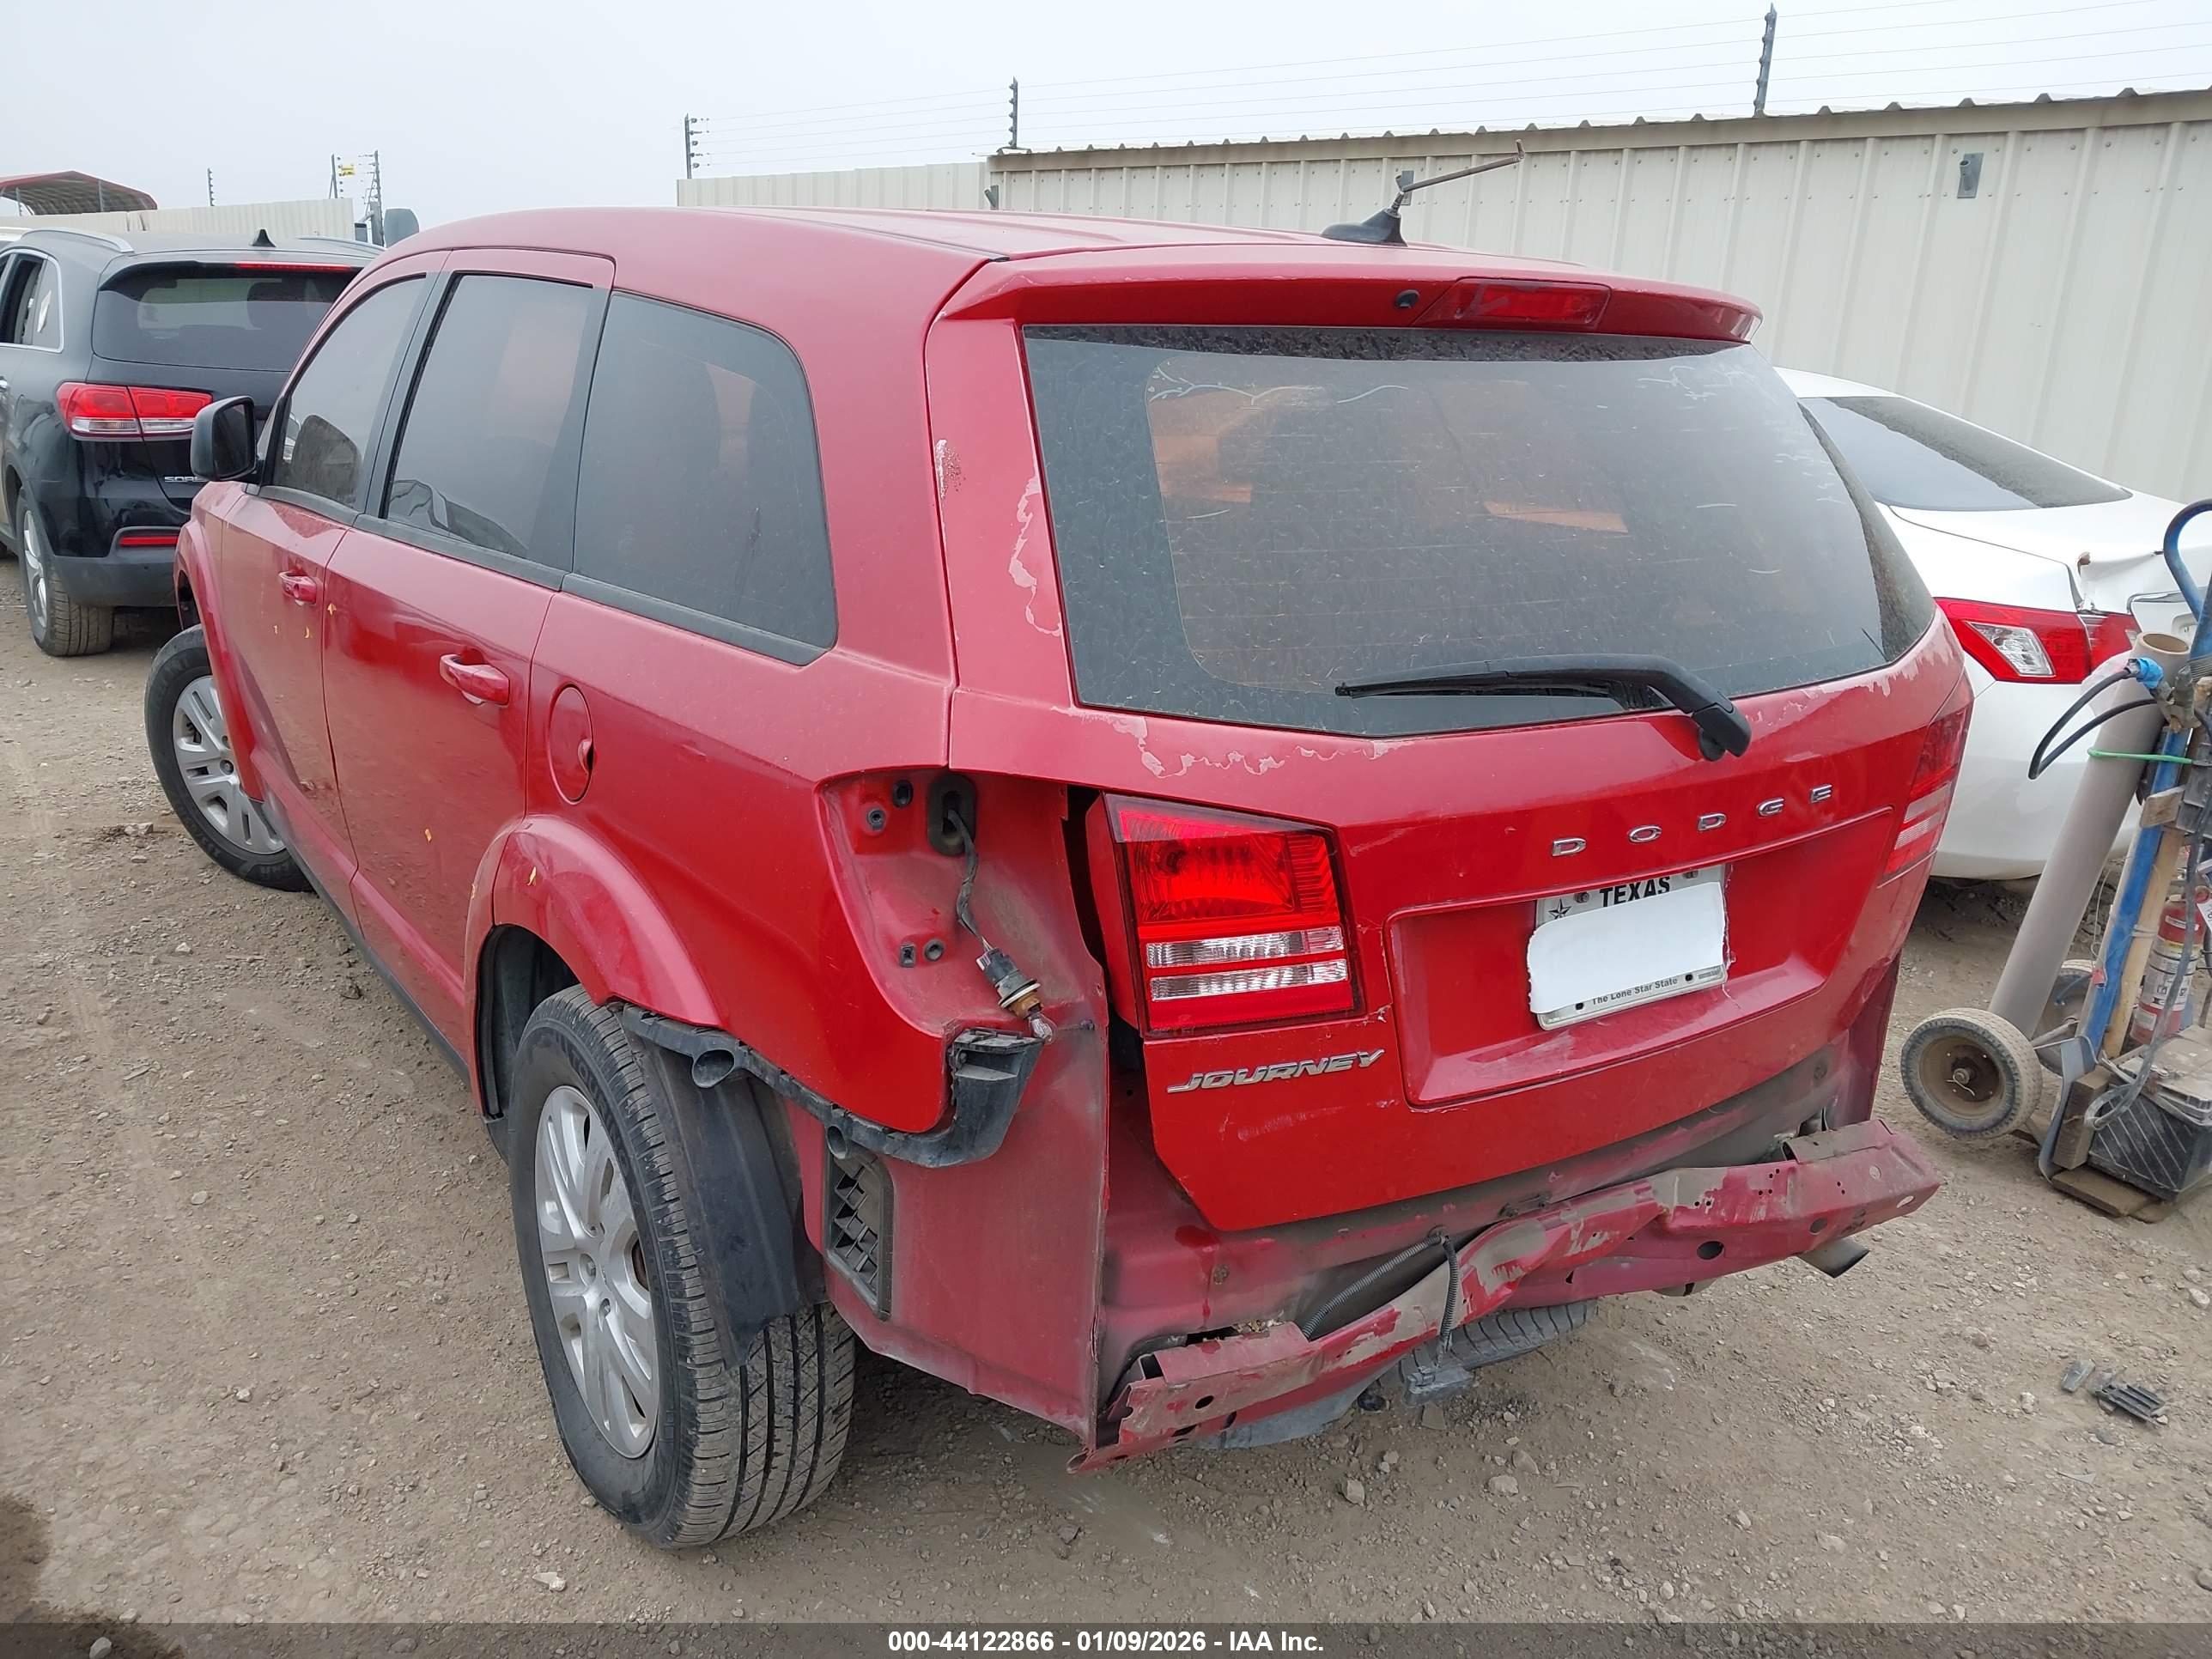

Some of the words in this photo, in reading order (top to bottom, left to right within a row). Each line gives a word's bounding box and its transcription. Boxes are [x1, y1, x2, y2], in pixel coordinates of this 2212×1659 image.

[1552, 783, 1832, 857] DODGE
[1599, 876, 1670, 908] TEXAS
[1592, 996, 1608, 1005] The
[1610, 989, 1632, 1000] Lone
[1634, 983, 1652, 994] Star
[1655, 977, 1678, 989] State
[1167, 1048, 1385, 1093] JOURNEY
